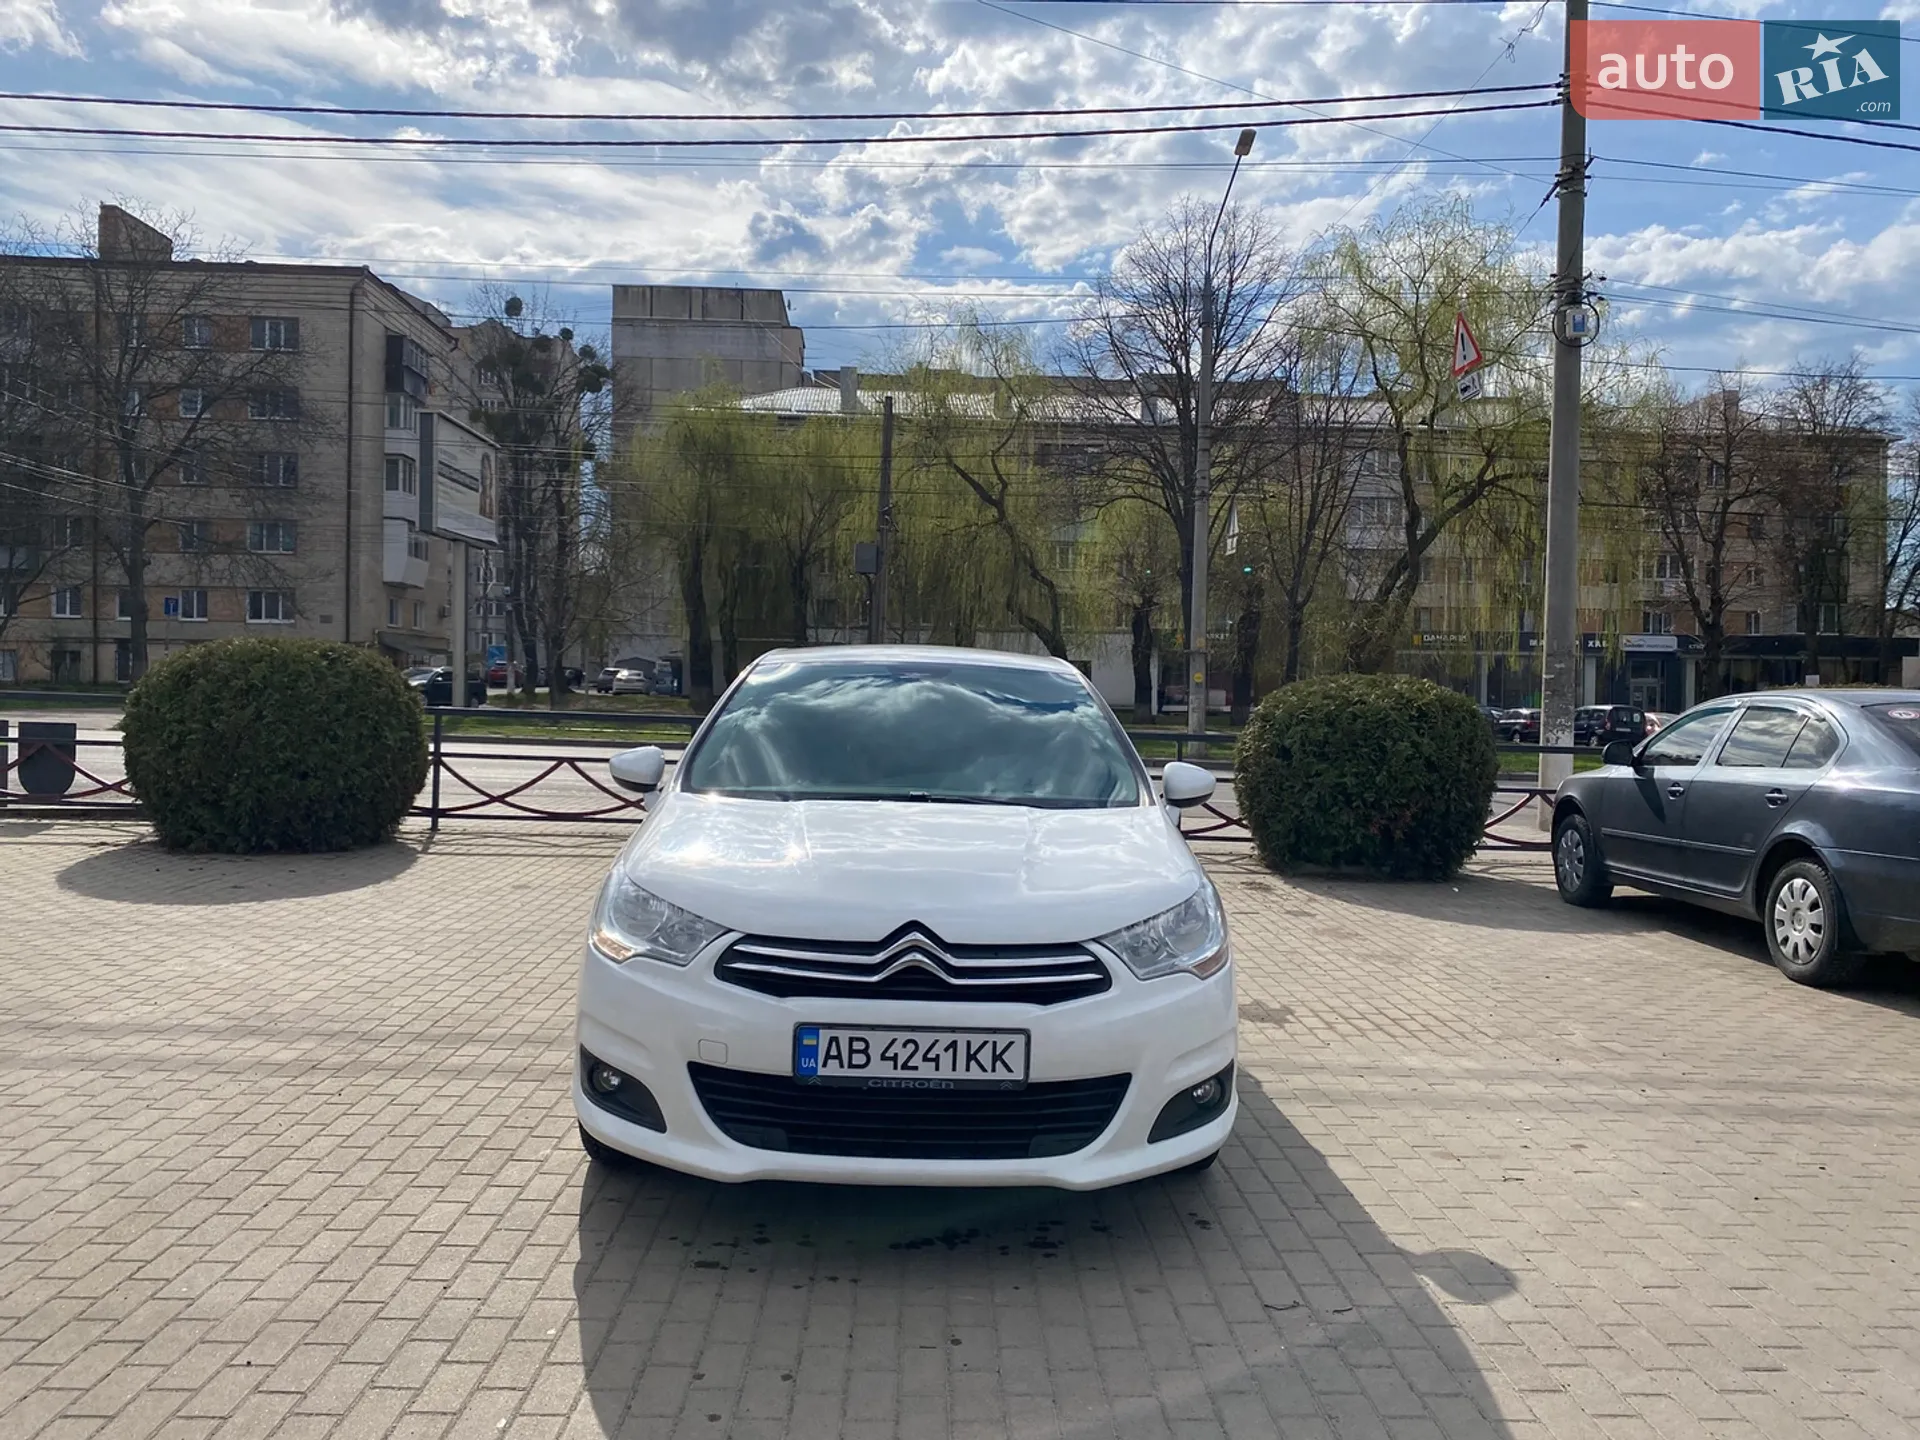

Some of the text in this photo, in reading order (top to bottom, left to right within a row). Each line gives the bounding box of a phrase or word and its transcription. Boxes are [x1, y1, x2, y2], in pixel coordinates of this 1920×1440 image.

[801, 1057, 817, 1069] UA
[821, 1036, 1016, 1074] AB 4241KK
